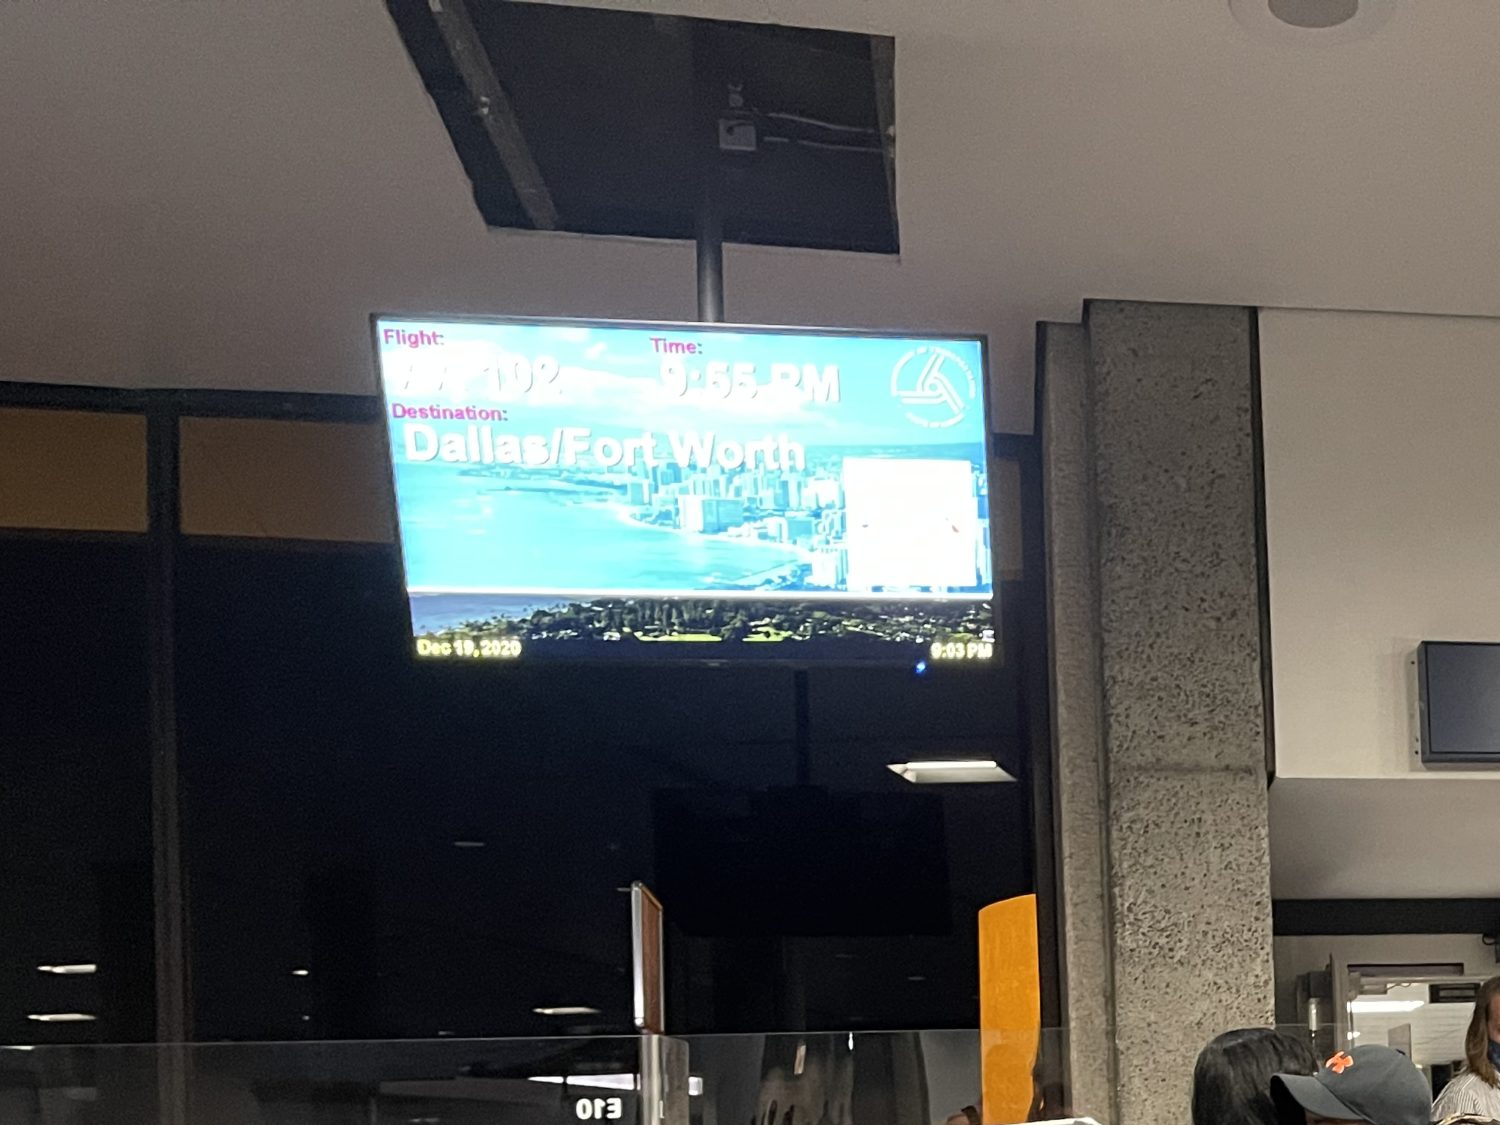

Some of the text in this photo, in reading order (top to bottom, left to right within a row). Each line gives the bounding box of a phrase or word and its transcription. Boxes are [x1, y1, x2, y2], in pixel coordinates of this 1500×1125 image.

[383, 329, 445, 348] Flight:
[650, 337, 703, 354] Time:
[770, 363, 841, 402] PM
[392, 403, 509, 421] Destination:
[404, 423, 806, 471] Dallas/Fort Worth
[417, 639, 452, 657] Dec
[967, 642, 993, 659] PM
